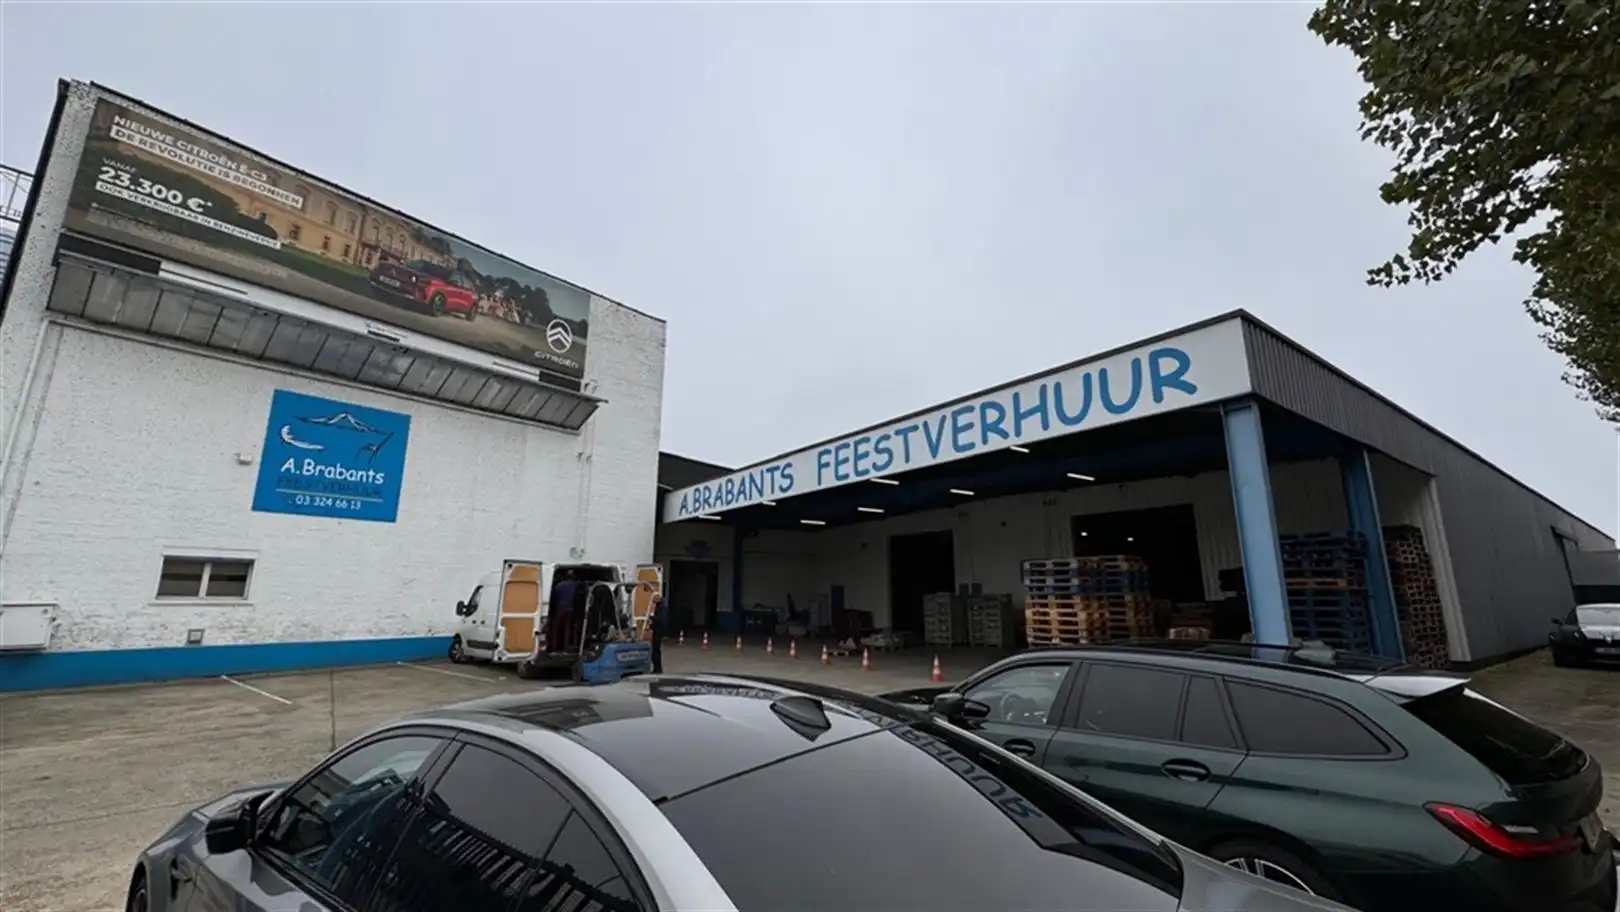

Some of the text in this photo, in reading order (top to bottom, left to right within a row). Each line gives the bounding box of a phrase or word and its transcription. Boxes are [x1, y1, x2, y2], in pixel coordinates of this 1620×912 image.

[114, 115, 176, 146] NIEUWE
[177, 140, 238, 169] CITROËN
[99, 166, 184, 204] 23.300
[115, 130, 302, 206] DE REVOLUTIE IS BEGONNEN
[679, 347, 1198, 516] A.BRABANTS FEESTVERHUUR
[281, 457, 385, 485] A.Brabants
[296, 494, 310, 506] 03
[314, 496, 333, 507] 324
